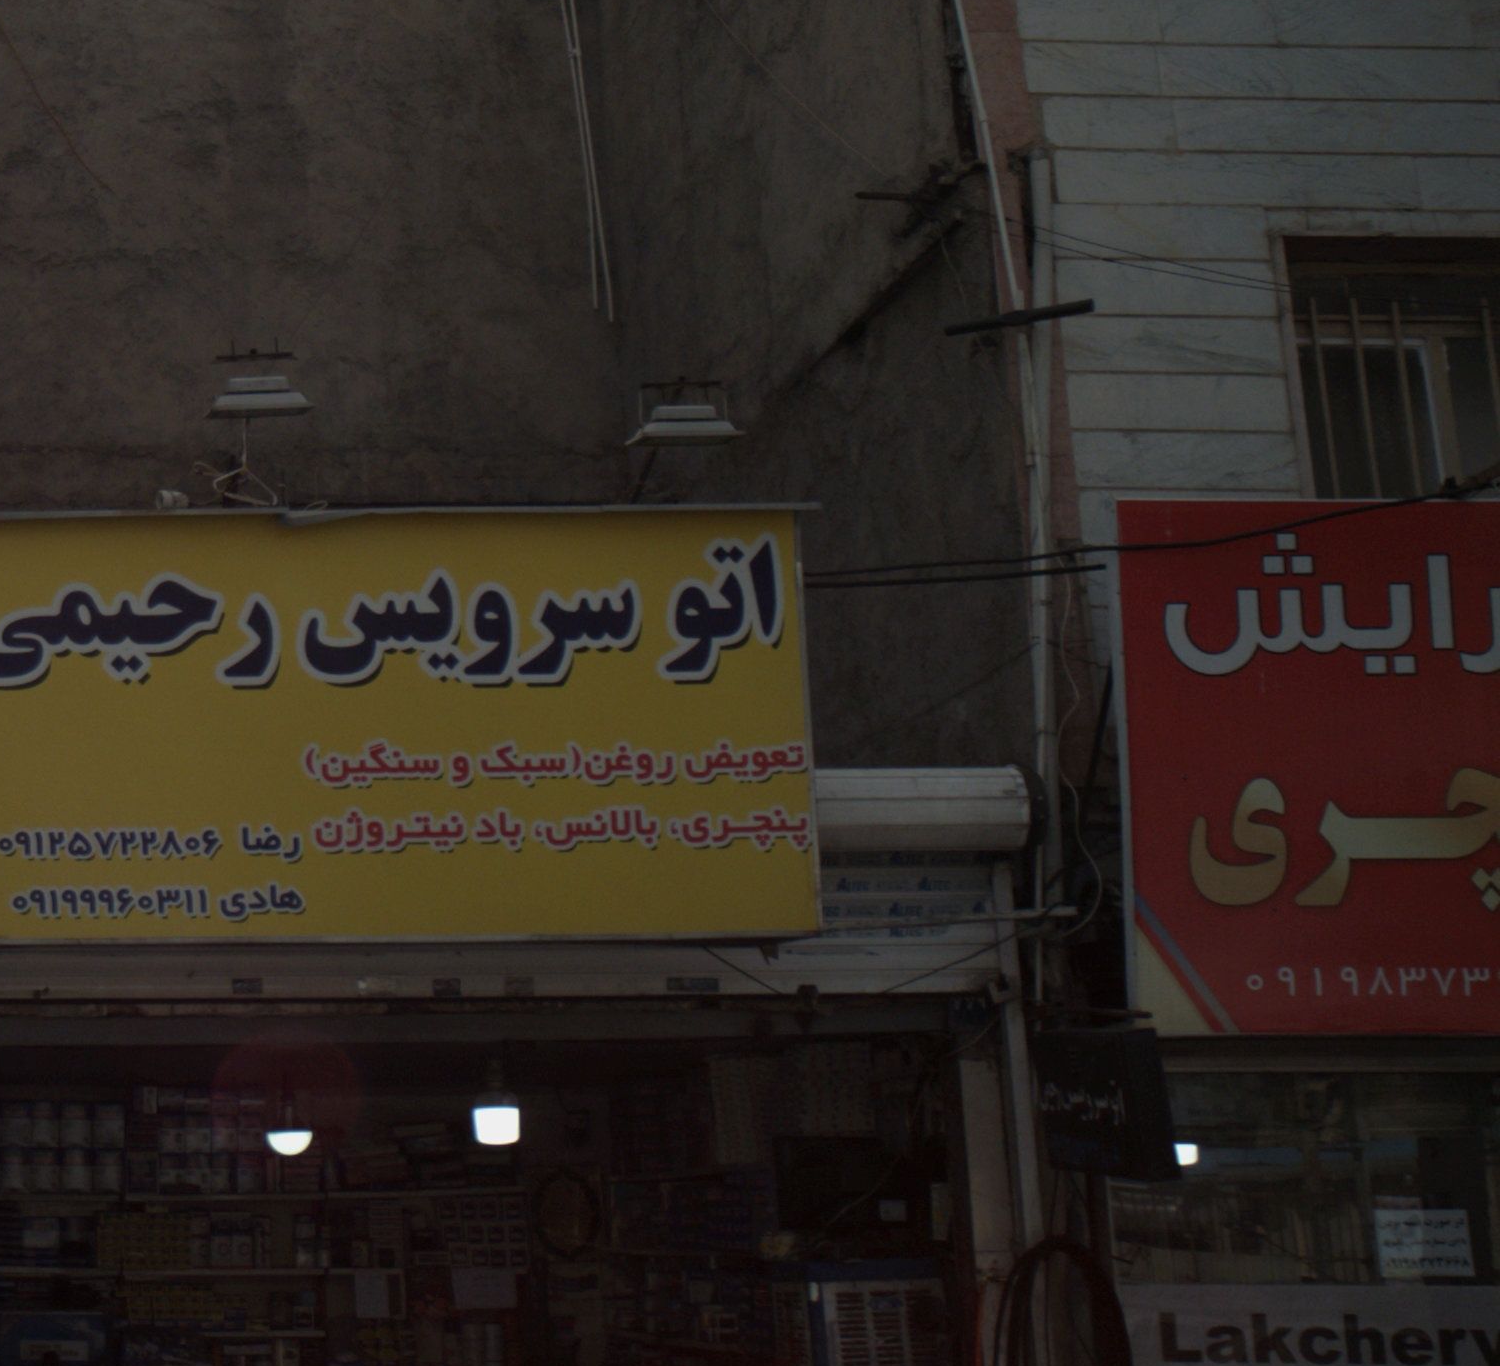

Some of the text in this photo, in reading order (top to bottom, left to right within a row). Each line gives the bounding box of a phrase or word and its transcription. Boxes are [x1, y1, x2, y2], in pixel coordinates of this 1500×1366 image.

[664, 539, 778, 675] اتو
[303, 575, 636, 677] سرویس
[451, 754, 470, 783] و
[684, 742, 805, 779] تعویض
[240, 825, 300, 859] رضا
[314, 810, 464, 848] نیتروژن
[476, 811, 522, 847] باد
[12, 884, 303, 918] هادی ۰۹۱۹۹۹۶۰۳۱۱
[1246, 966, 1500, 997] ۰۹۱۹۸۳۷۳
